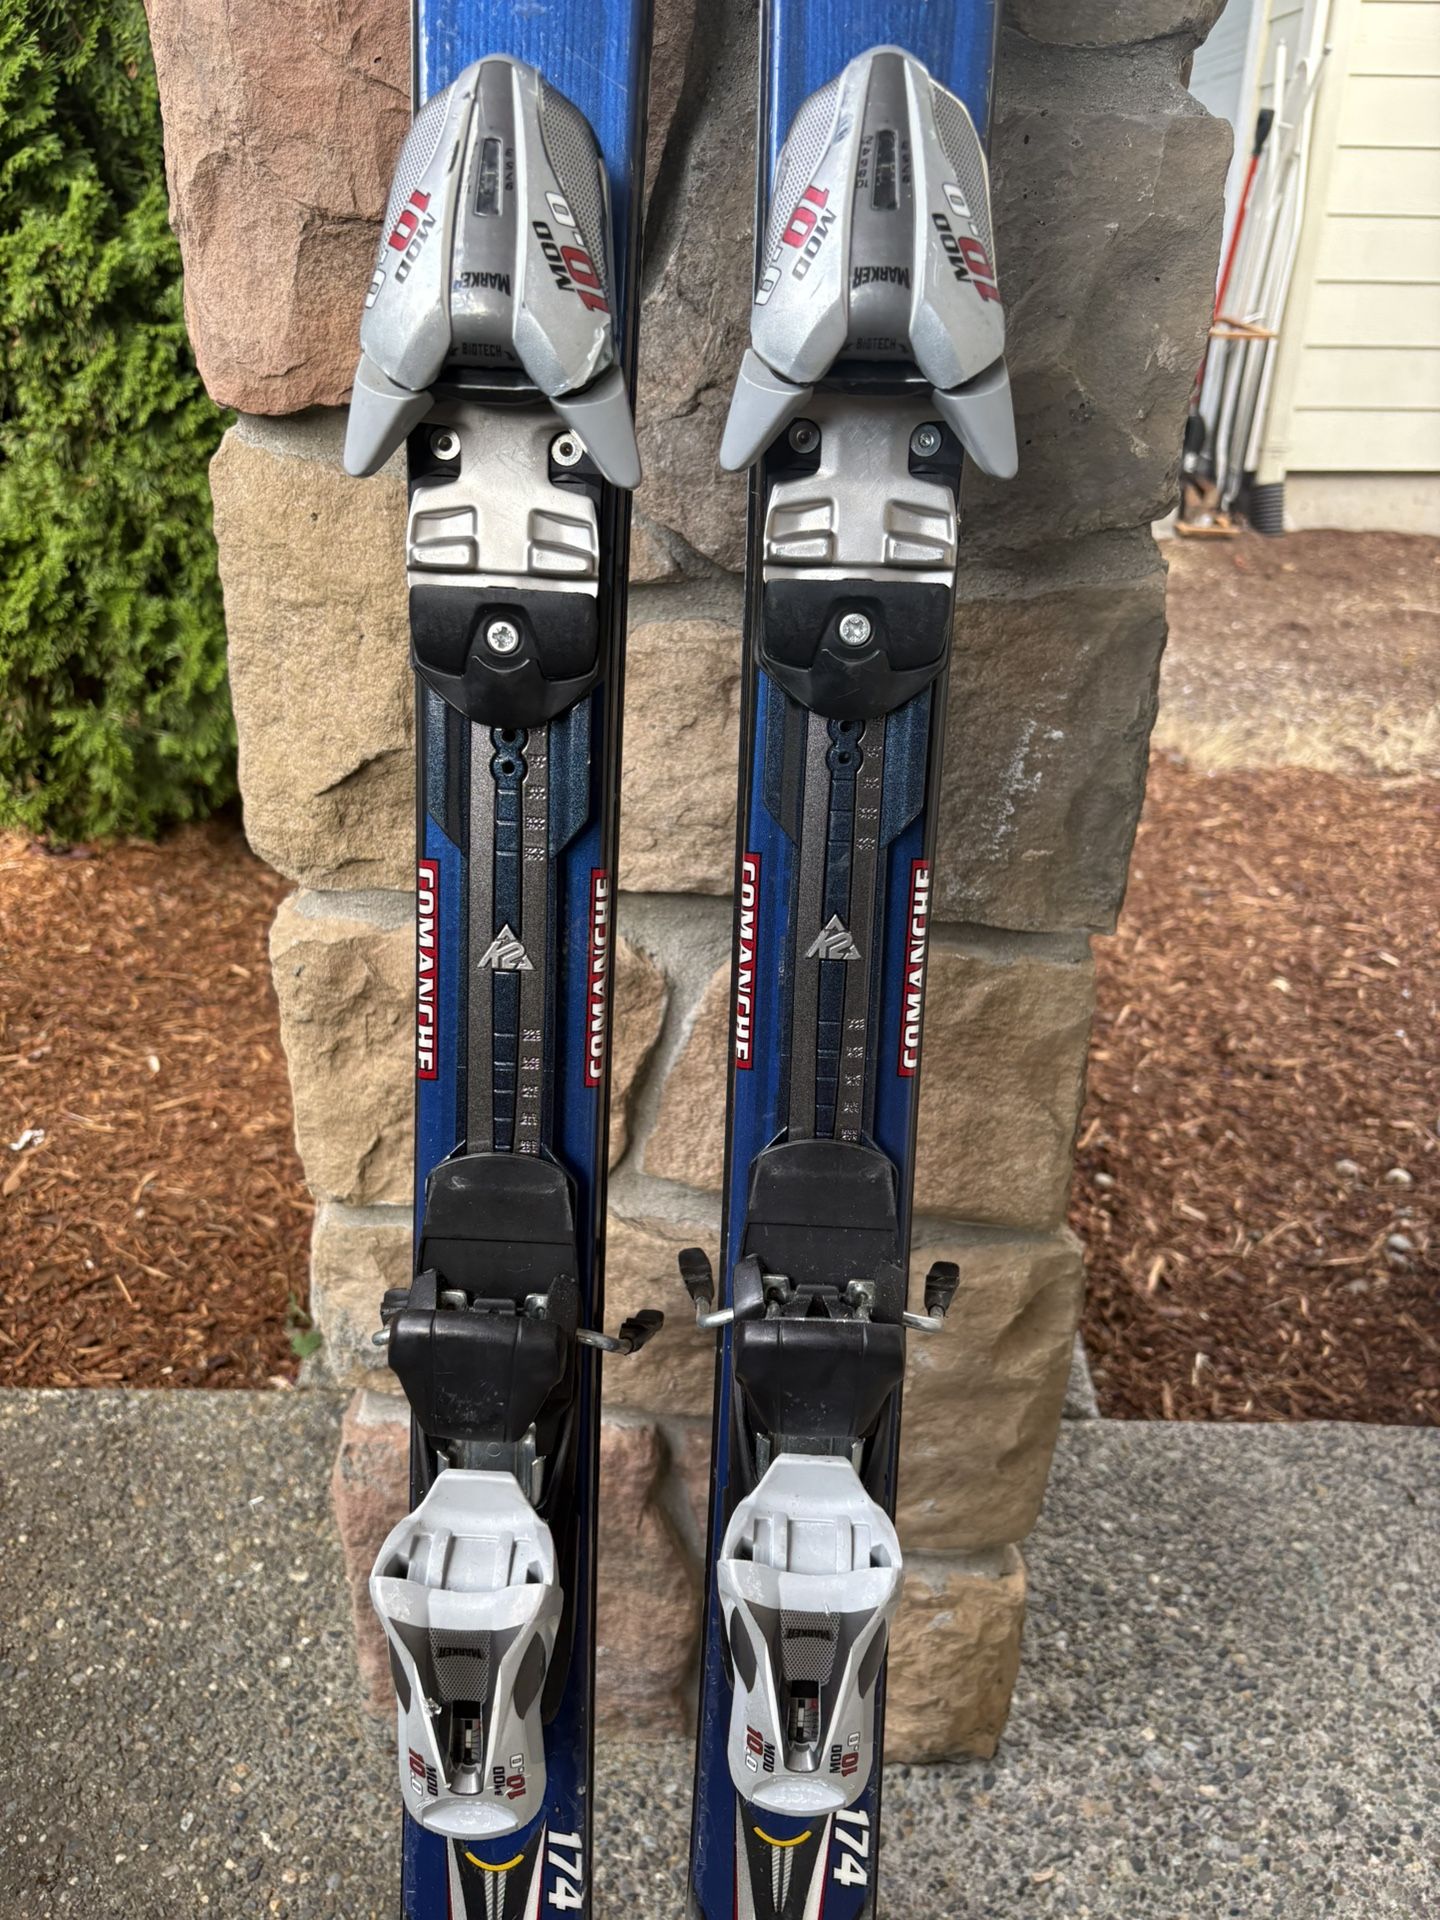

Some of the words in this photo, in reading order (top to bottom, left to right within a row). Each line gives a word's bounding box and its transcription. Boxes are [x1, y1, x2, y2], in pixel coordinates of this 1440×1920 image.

[395, 211, 436, 284] MOD
[532, 220, 575, 291] MOD
[792, 208, 836, 281] MOD
[853, 266, 910, 290] MARKER
[932, 212, 972, 282] MOD
[462, 342, 502, 355] BIOTECH
[418, 868, 435, 1071] COMANCHE
[589, 878, 608, 1078] COMANCHE
[736, 861, 756, 1060] COMANCHE
[903, 868, 929, 1068] COMANCHE
[425, 1763, 438, 1797] MOD
[493, 1766, 504, 1796] MOD
[763, 1741, 776, 1773] MOD
[830, 1744, 842, 1773] MOD
[548, 1831, 584, 1911] 174
[833, 1808, 870, 1886] 174
